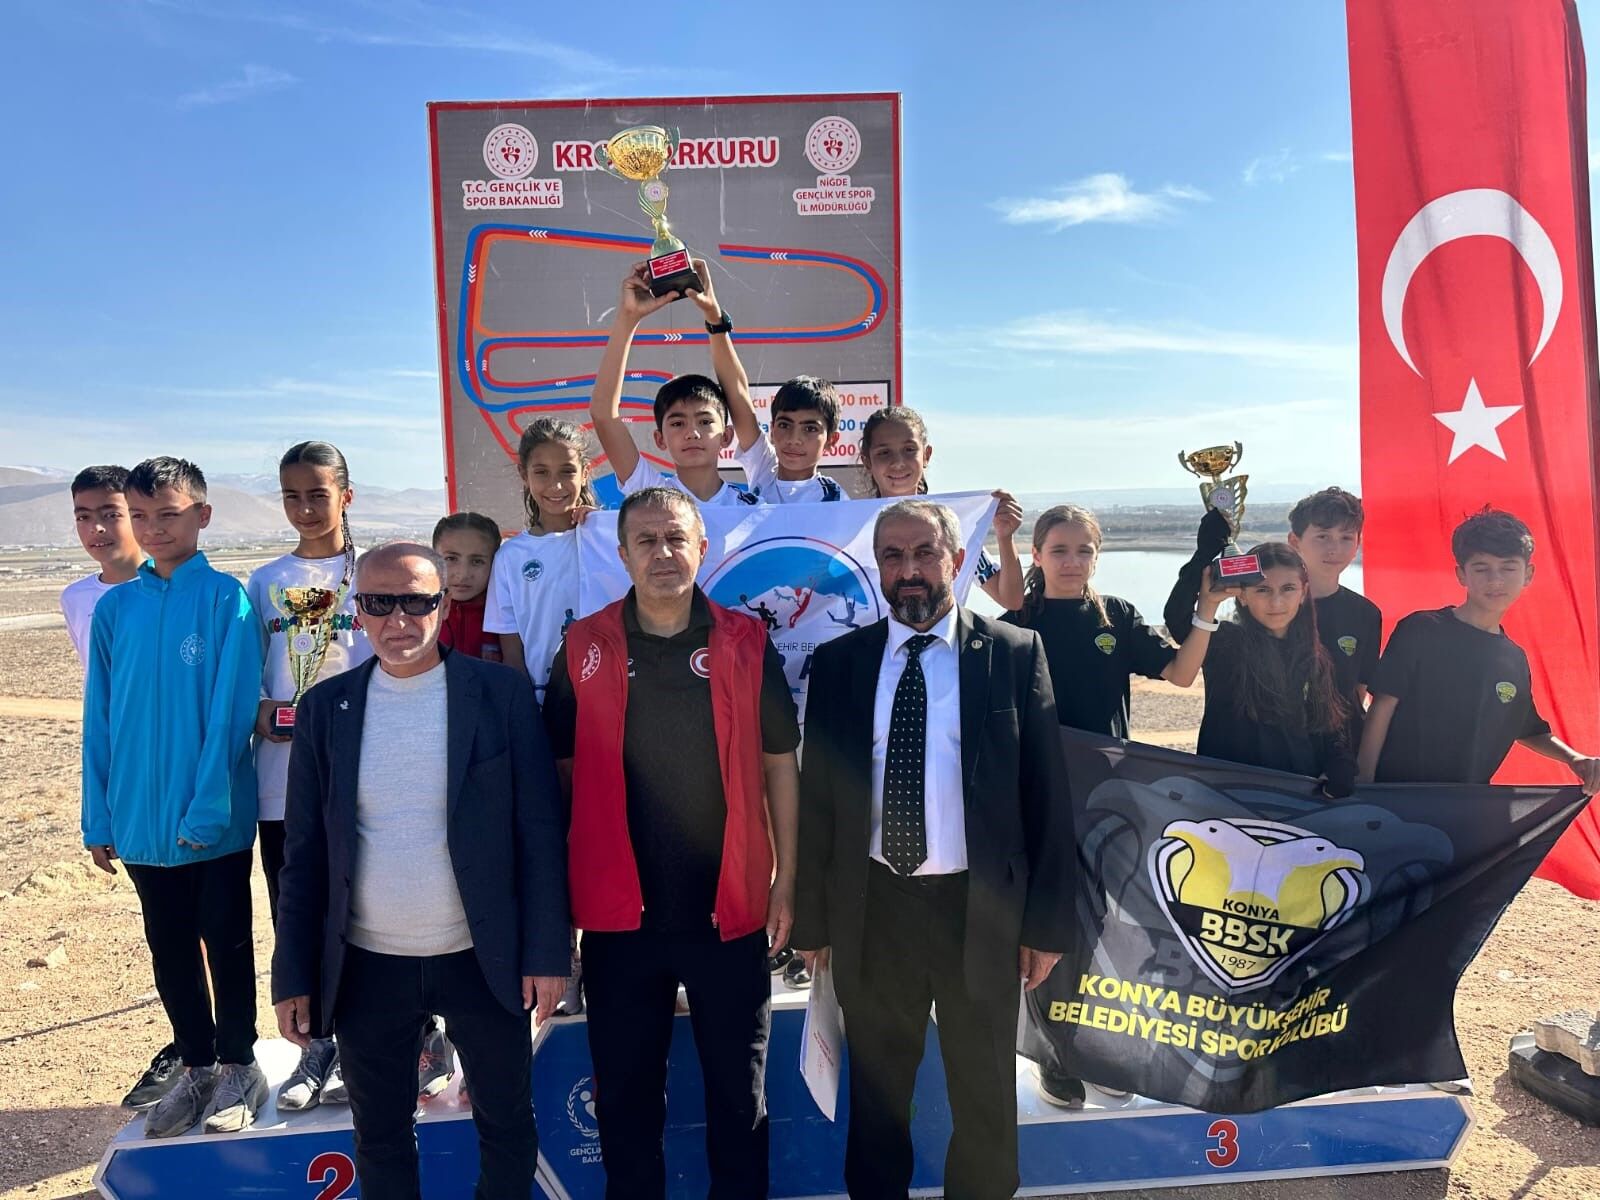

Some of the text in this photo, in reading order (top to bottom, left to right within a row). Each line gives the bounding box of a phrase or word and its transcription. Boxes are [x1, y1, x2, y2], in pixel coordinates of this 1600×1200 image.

[465, 181, 560, 195] T.C. GENÇLİK VE
[819, 177, 848, 187] NİĞDE
[466, 194, 560, 207] SPOR BAKANLIĞI
[835, 191, 847, 199] VE
[848, 190, 872, 199] SPOR
[809, 202, 868, 213] MÜDÜRLÜĞÜ
[1222, 898, 1280, 921] KONYA
[1199, 911, 1295, 955] BBSK
[1220, 954, 1257, 971] 1987
[1078, 974, 1182, 1014] KONYA
[1049, 1001, 1198, 1050] BELEDİYESİ
[1200, 1029, 1271, 1061] SPOR
[1206, 1119, 1240, 1168] 3
[307, 1152, 358, 1200] 2
